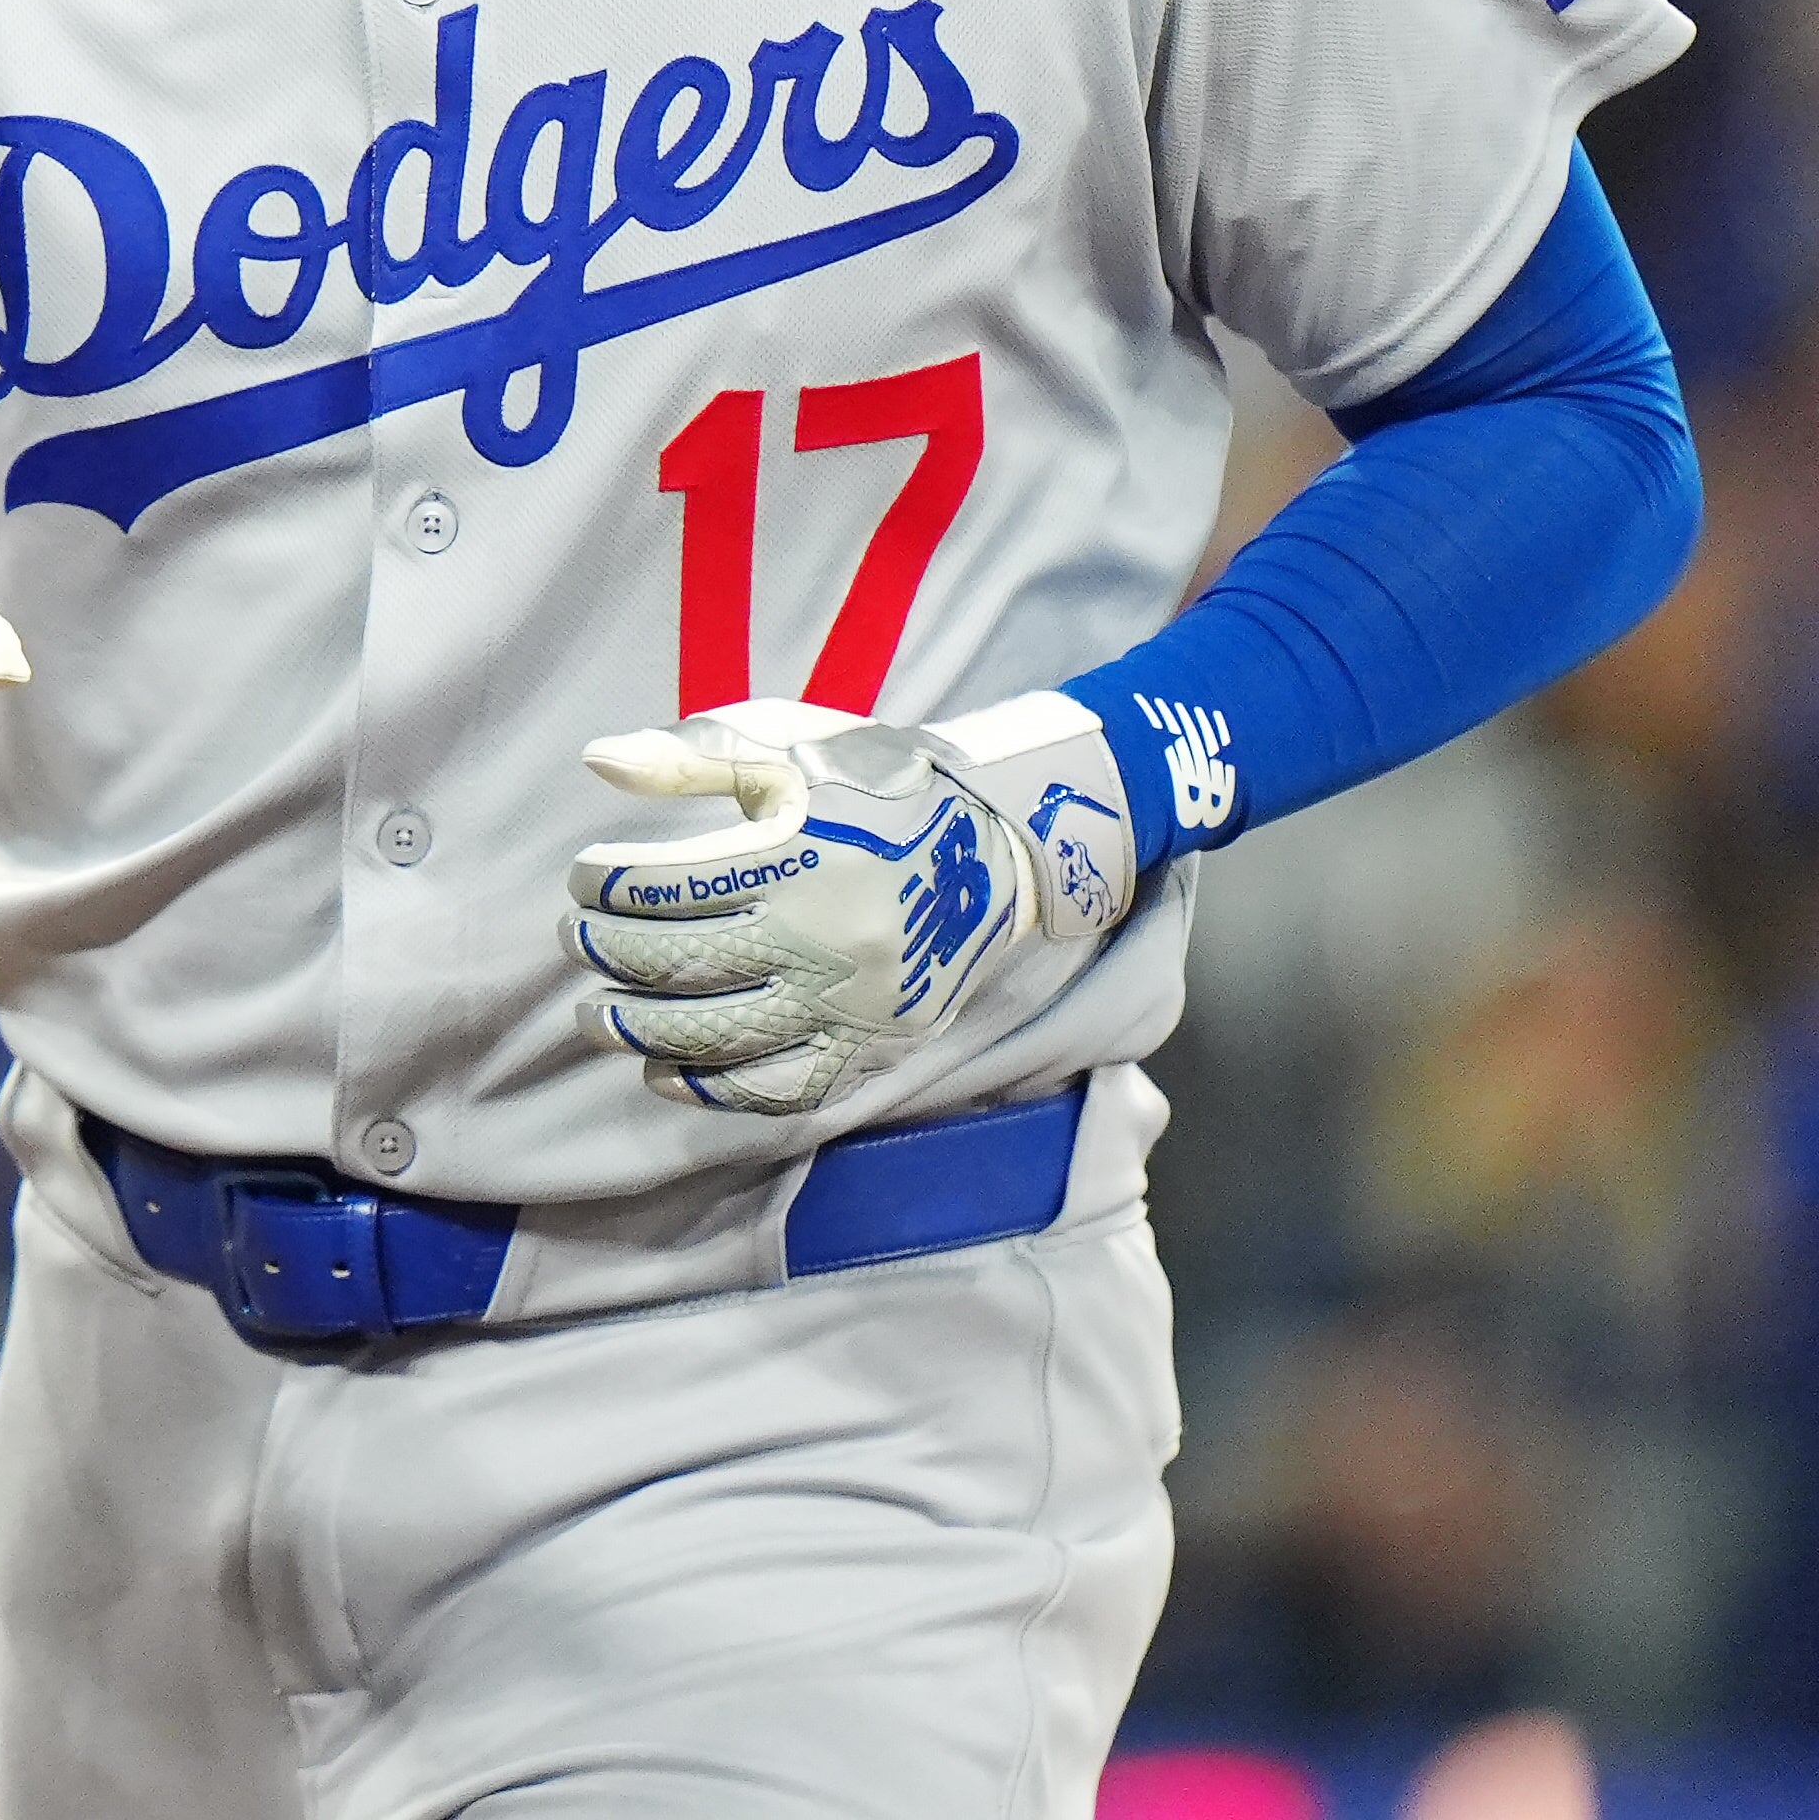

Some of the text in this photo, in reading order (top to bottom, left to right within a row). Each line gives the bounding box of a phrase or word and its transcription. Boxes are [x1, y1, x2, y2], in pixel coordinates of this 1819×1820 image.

[659, 352, 985, 722] 17
[628, 849, 819, 906] new balance
